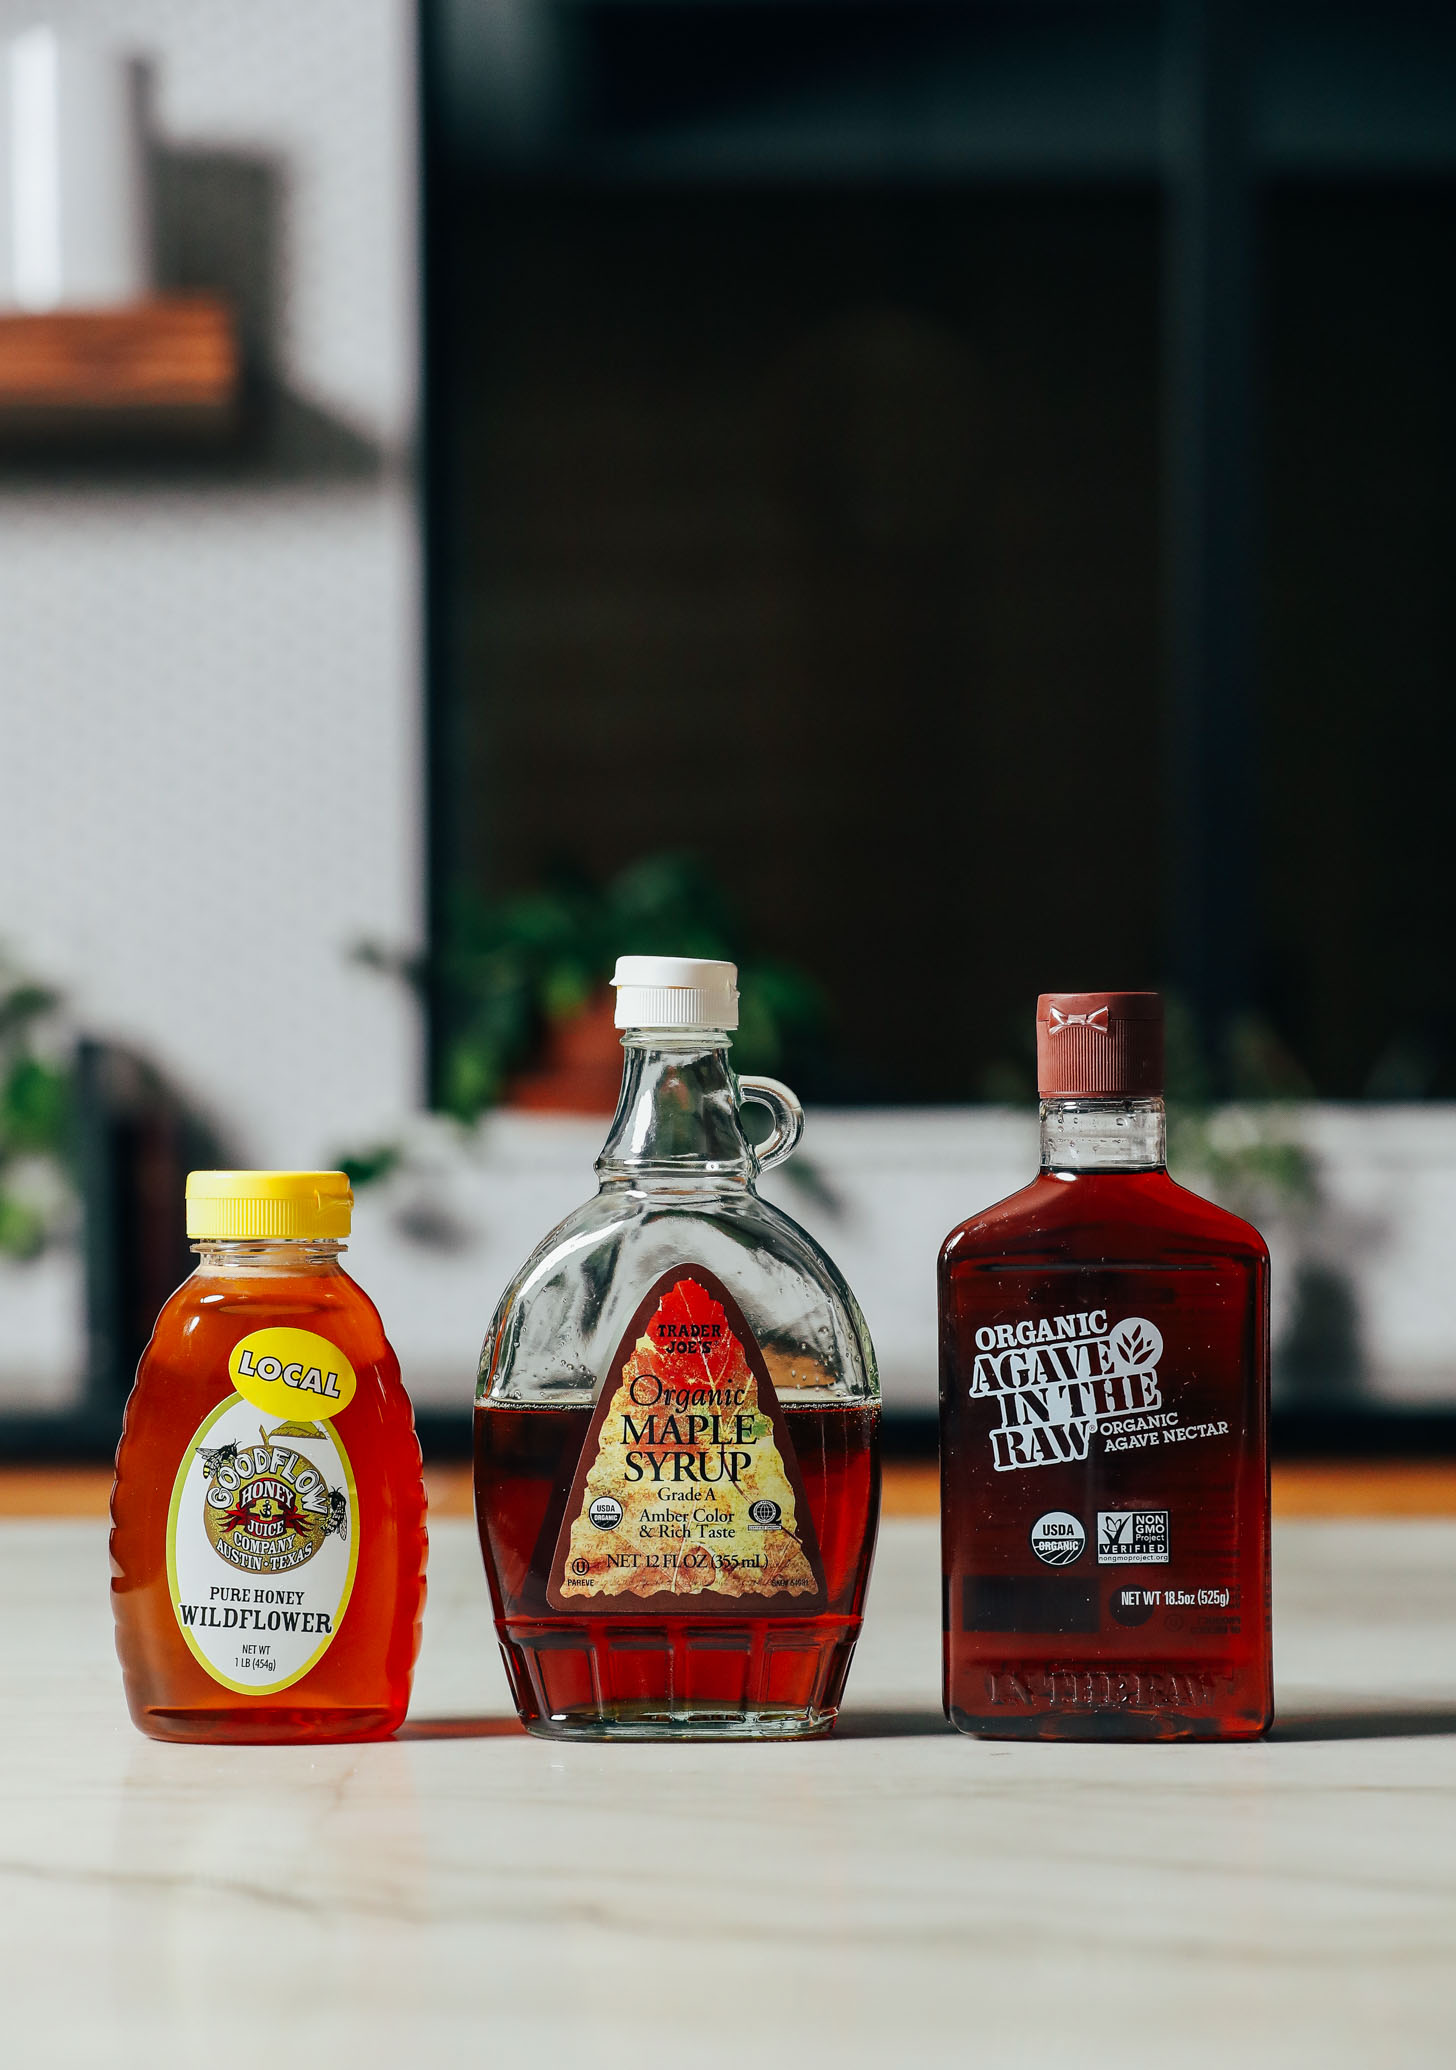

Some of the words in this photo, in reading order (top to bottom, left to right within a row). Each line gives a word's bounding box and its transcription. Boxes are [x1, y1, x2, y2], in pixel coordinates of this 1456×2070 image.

[657, 1324, 722, 1338] TRADER
[974, 1309, 1109, 1351] ORGANIC
[665, 1340, 713, 1354] JOE'S
[238, 1350, 341, 1399] LOCAL
[972, 1339, 1116, 1395] AGAVE
[629, 1374, 746, 1414] Organic
[1000, 1386, 1051, 1429] IN
[1057, 1371, 1160, 1420] THE
[620, 1414, 758, 1445] MAPLE
[1100, 1411, 1180, 1436] ORGANIC
[1104, 1431, 1160, 1453] AGAVE
[1163, 1420, 1230, 1444] NECTAR
[624, 1450, 753, 1483] SYRUP
[206, 1447, 330, 1516] GOODFLOW
[240, 1480, 294, 1510] HONEY
[657, 1486, 702, 1501] Grade
[705, 1486, 716, 1501] A
[596, 1504, 616, 1513] USDA
[639, 1507, 689, 1522] Amber
[693, 1507, 735, 1523] Color
[247, 1518, 286, 1537] JUICE
[1135, 1515, 1164, 1525] NON
[1135, 1524, 1165, 1534] GMO
[639, 1524, 652, 1538] &
[659, 1524, 691, 1538] Rich
[696, 1524, 736, 1538] Taste
[1042, 1524, 1075, 1536] USDA
[1135, 1533, 1165, 1542] Project
[233, 1531, 297, 1555] COMPANY
[1038, 1540, 1079, 1551] ORGANIC
[1102, 1544, 1165, 1554] VERIFIED
[216, 1538, 263, 1571] AUSTIN
[270, 1541, 314, 1572] TEXAS
[606, 1553, 641, 1568] NET
[645, 1554, 660, 1568] 12
[663, 1553, 681, 1568] FL
[683, 1553, 708, 1568] OZ
[567, 1578, 594, 1587] PAREVE
[209, 1586, 251, 1603] PURE
[253, 1589, 305, 1606] HONEY
[1121, 1591, 1141, 1606] NET
[1143, 1590, 1162, 1606] WT
[1164, 1590, 1196, 1605] 18.5oz
[1197, 1588, 1230, 1608] (525g)
[180, 1604, 333, 1634] WILDFLOWER
[242, 1644, 257, 1655] NET
[258, 1645, 271, 1656] WT
[240, 1658, 251, 1668] LB
[252, 1658, 277, 1672] (454g)
